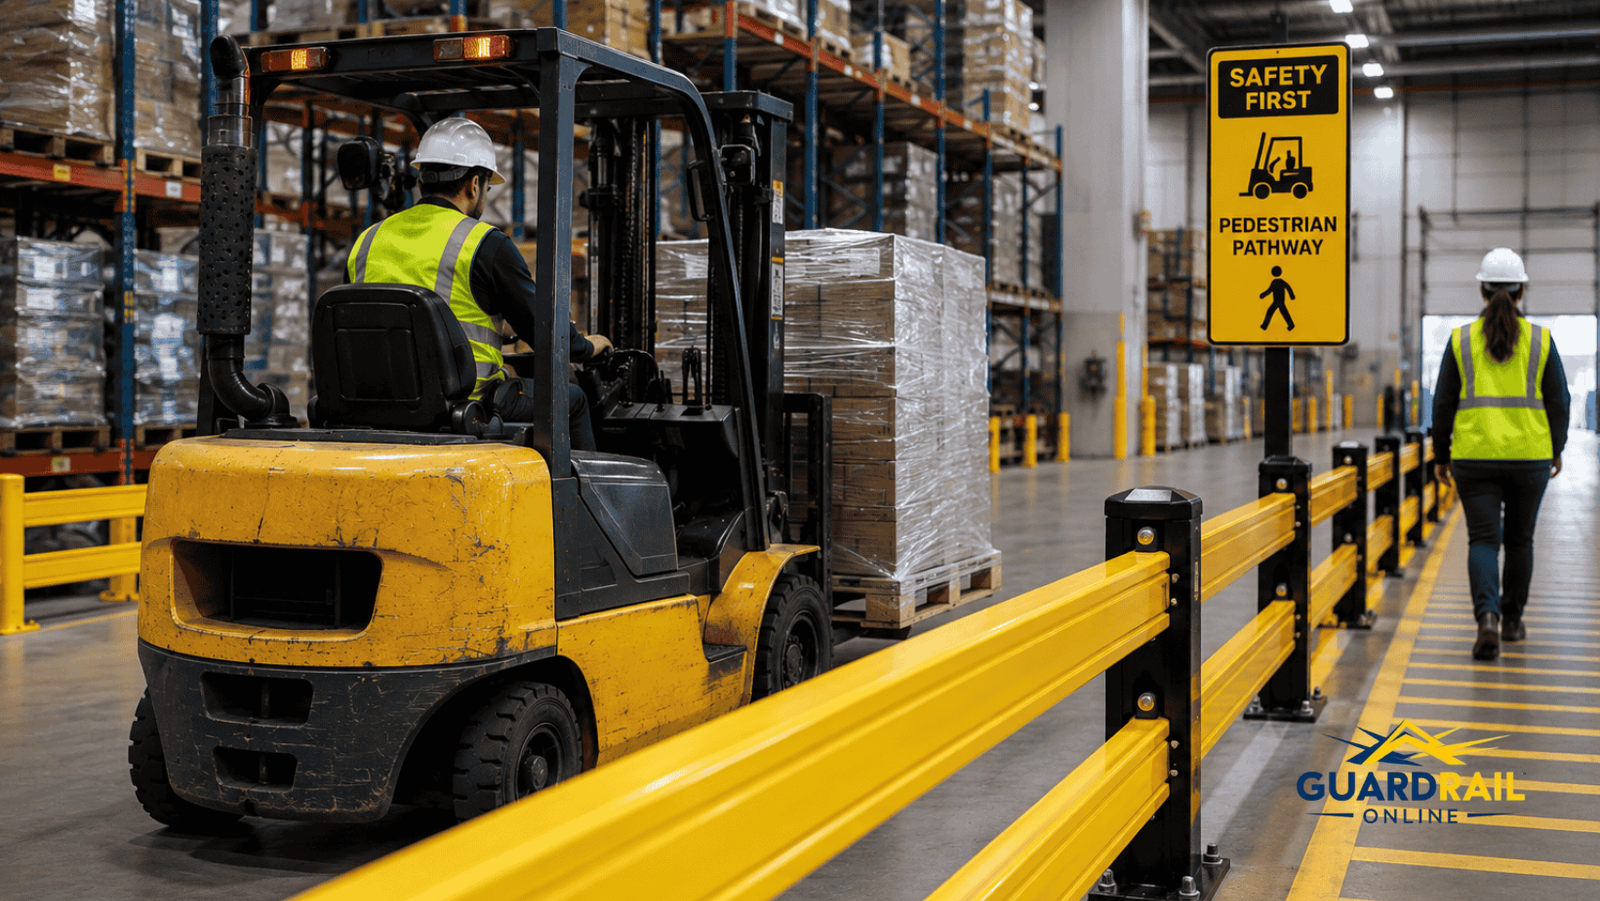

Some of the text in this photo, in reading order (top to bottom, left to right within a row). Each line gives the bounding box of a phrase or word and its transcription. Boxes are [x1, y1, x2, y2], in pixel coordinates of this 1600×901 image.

[1229, 63, 1328, 88] SAFETY
[1246, 89, 1312, 111] FIRST
[1219, 216, 1337, 233] PEDESTRIAN
[1232, 239, 1324, 256] PATHWAY
